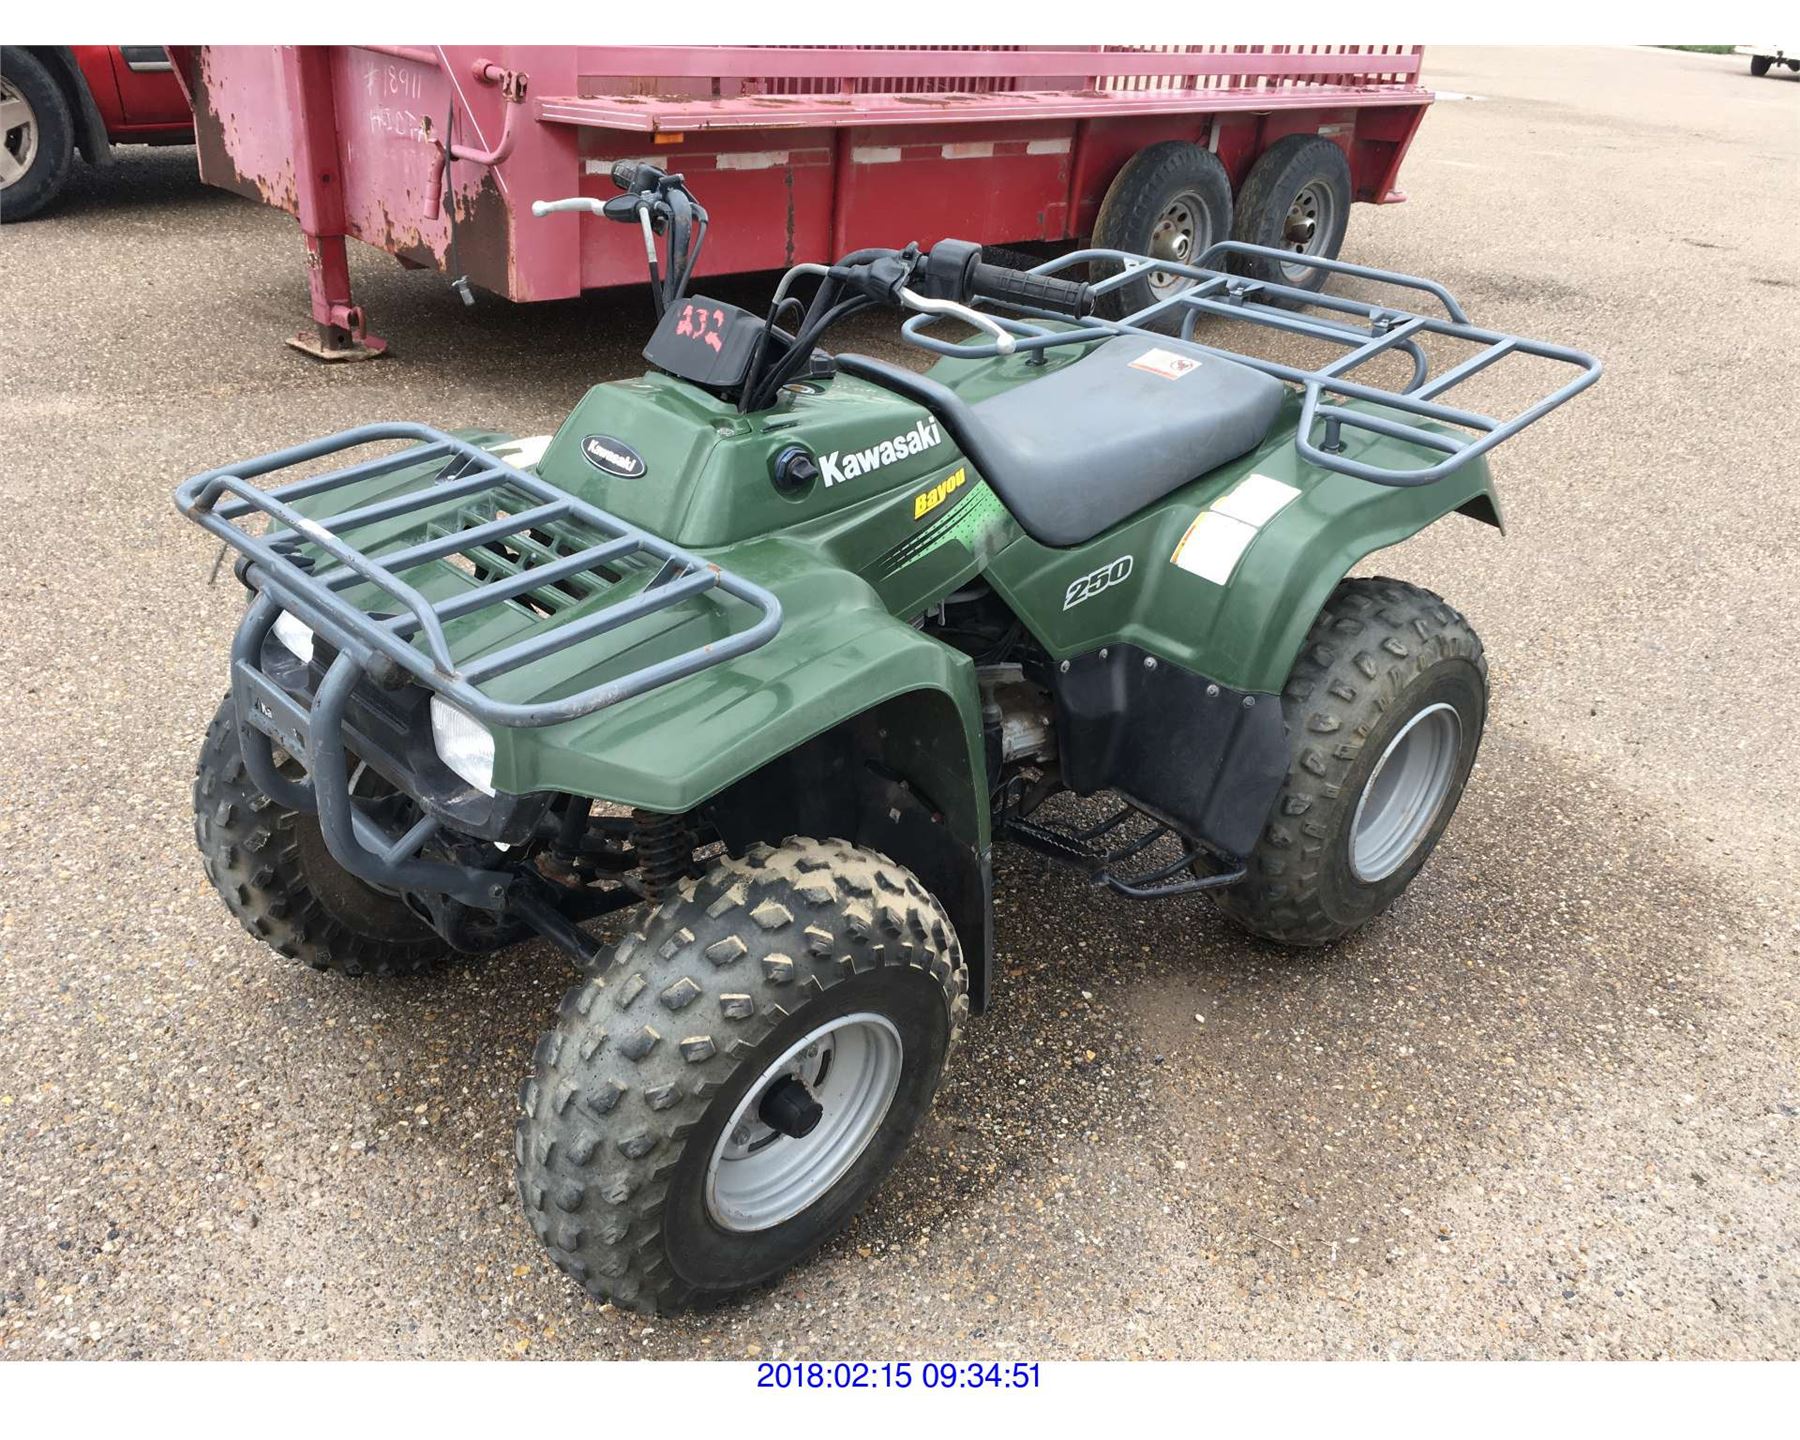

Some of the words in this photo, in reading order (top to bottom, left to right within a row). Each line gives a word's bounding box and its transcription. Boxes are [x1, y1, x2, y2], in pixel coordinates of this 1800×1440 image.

[676, 304, 725, 353] 232
[587, 439, 637, 472] Kawasaki
[818, 415, 941, 488] Kawasaki
[914, 467, 966, 520] Bayou
[1062, 554, 1134, 612] 250
